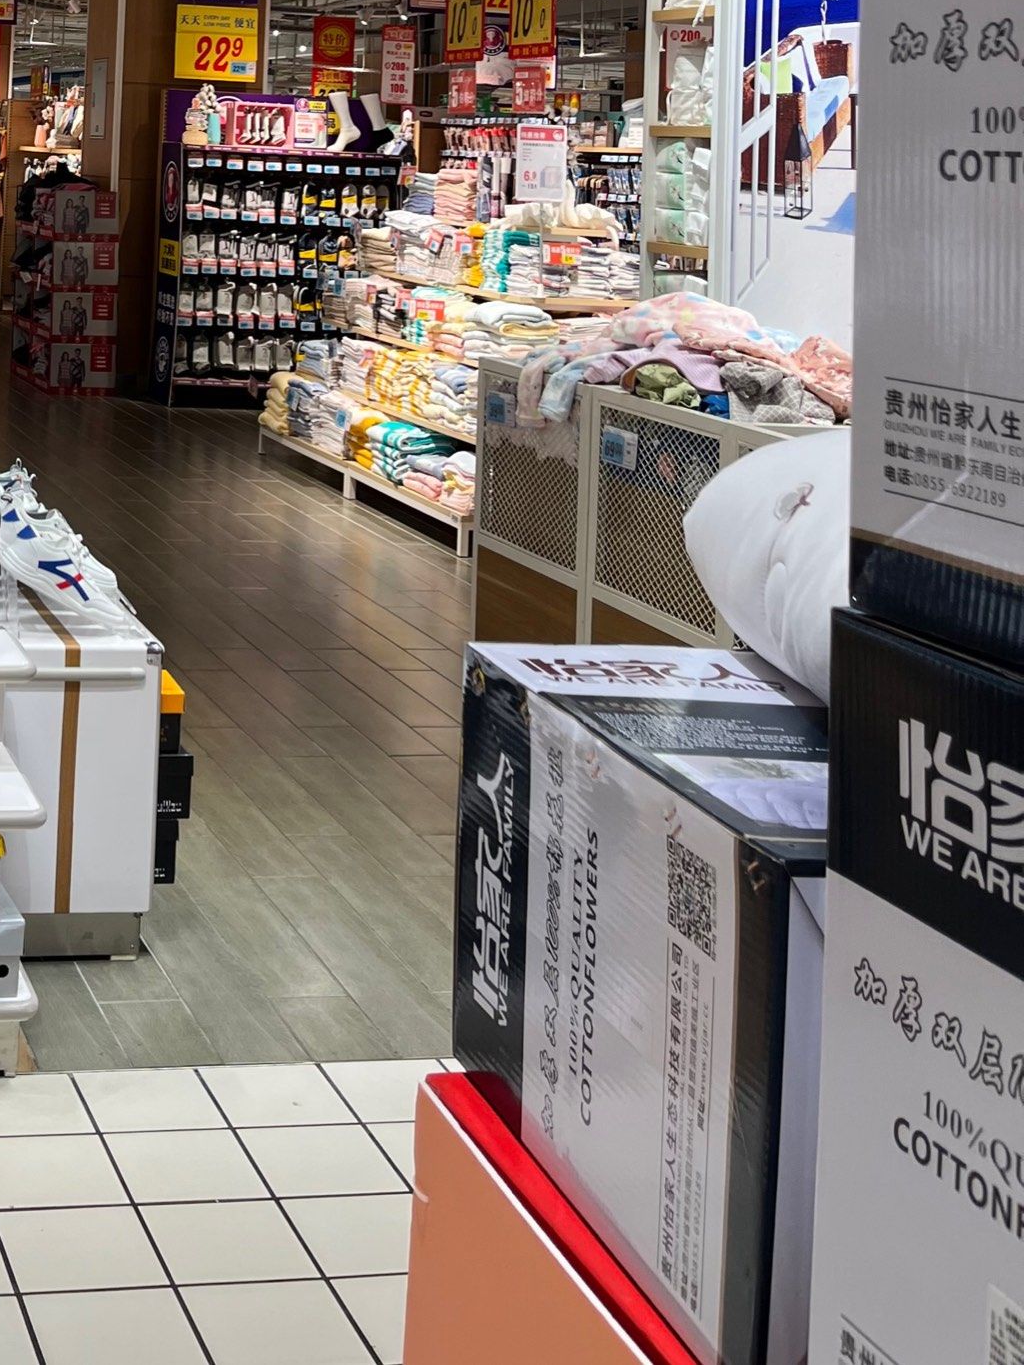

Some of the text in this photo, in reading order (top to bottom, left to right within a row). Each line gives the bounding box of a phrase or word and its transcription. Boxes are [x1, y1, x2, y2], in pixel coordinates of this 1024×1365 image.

[181, 15, 200, 25] 天天
[939, 148, 1024, 184] COTT
[884, 388, 1022, 441] 贵州怡家人生
[900, 814, 953, 872] WE
[497, 760, 515, 1029] WE ARE FAMILY
[580, 827, 599, 1127] COTTONFLOWERS
